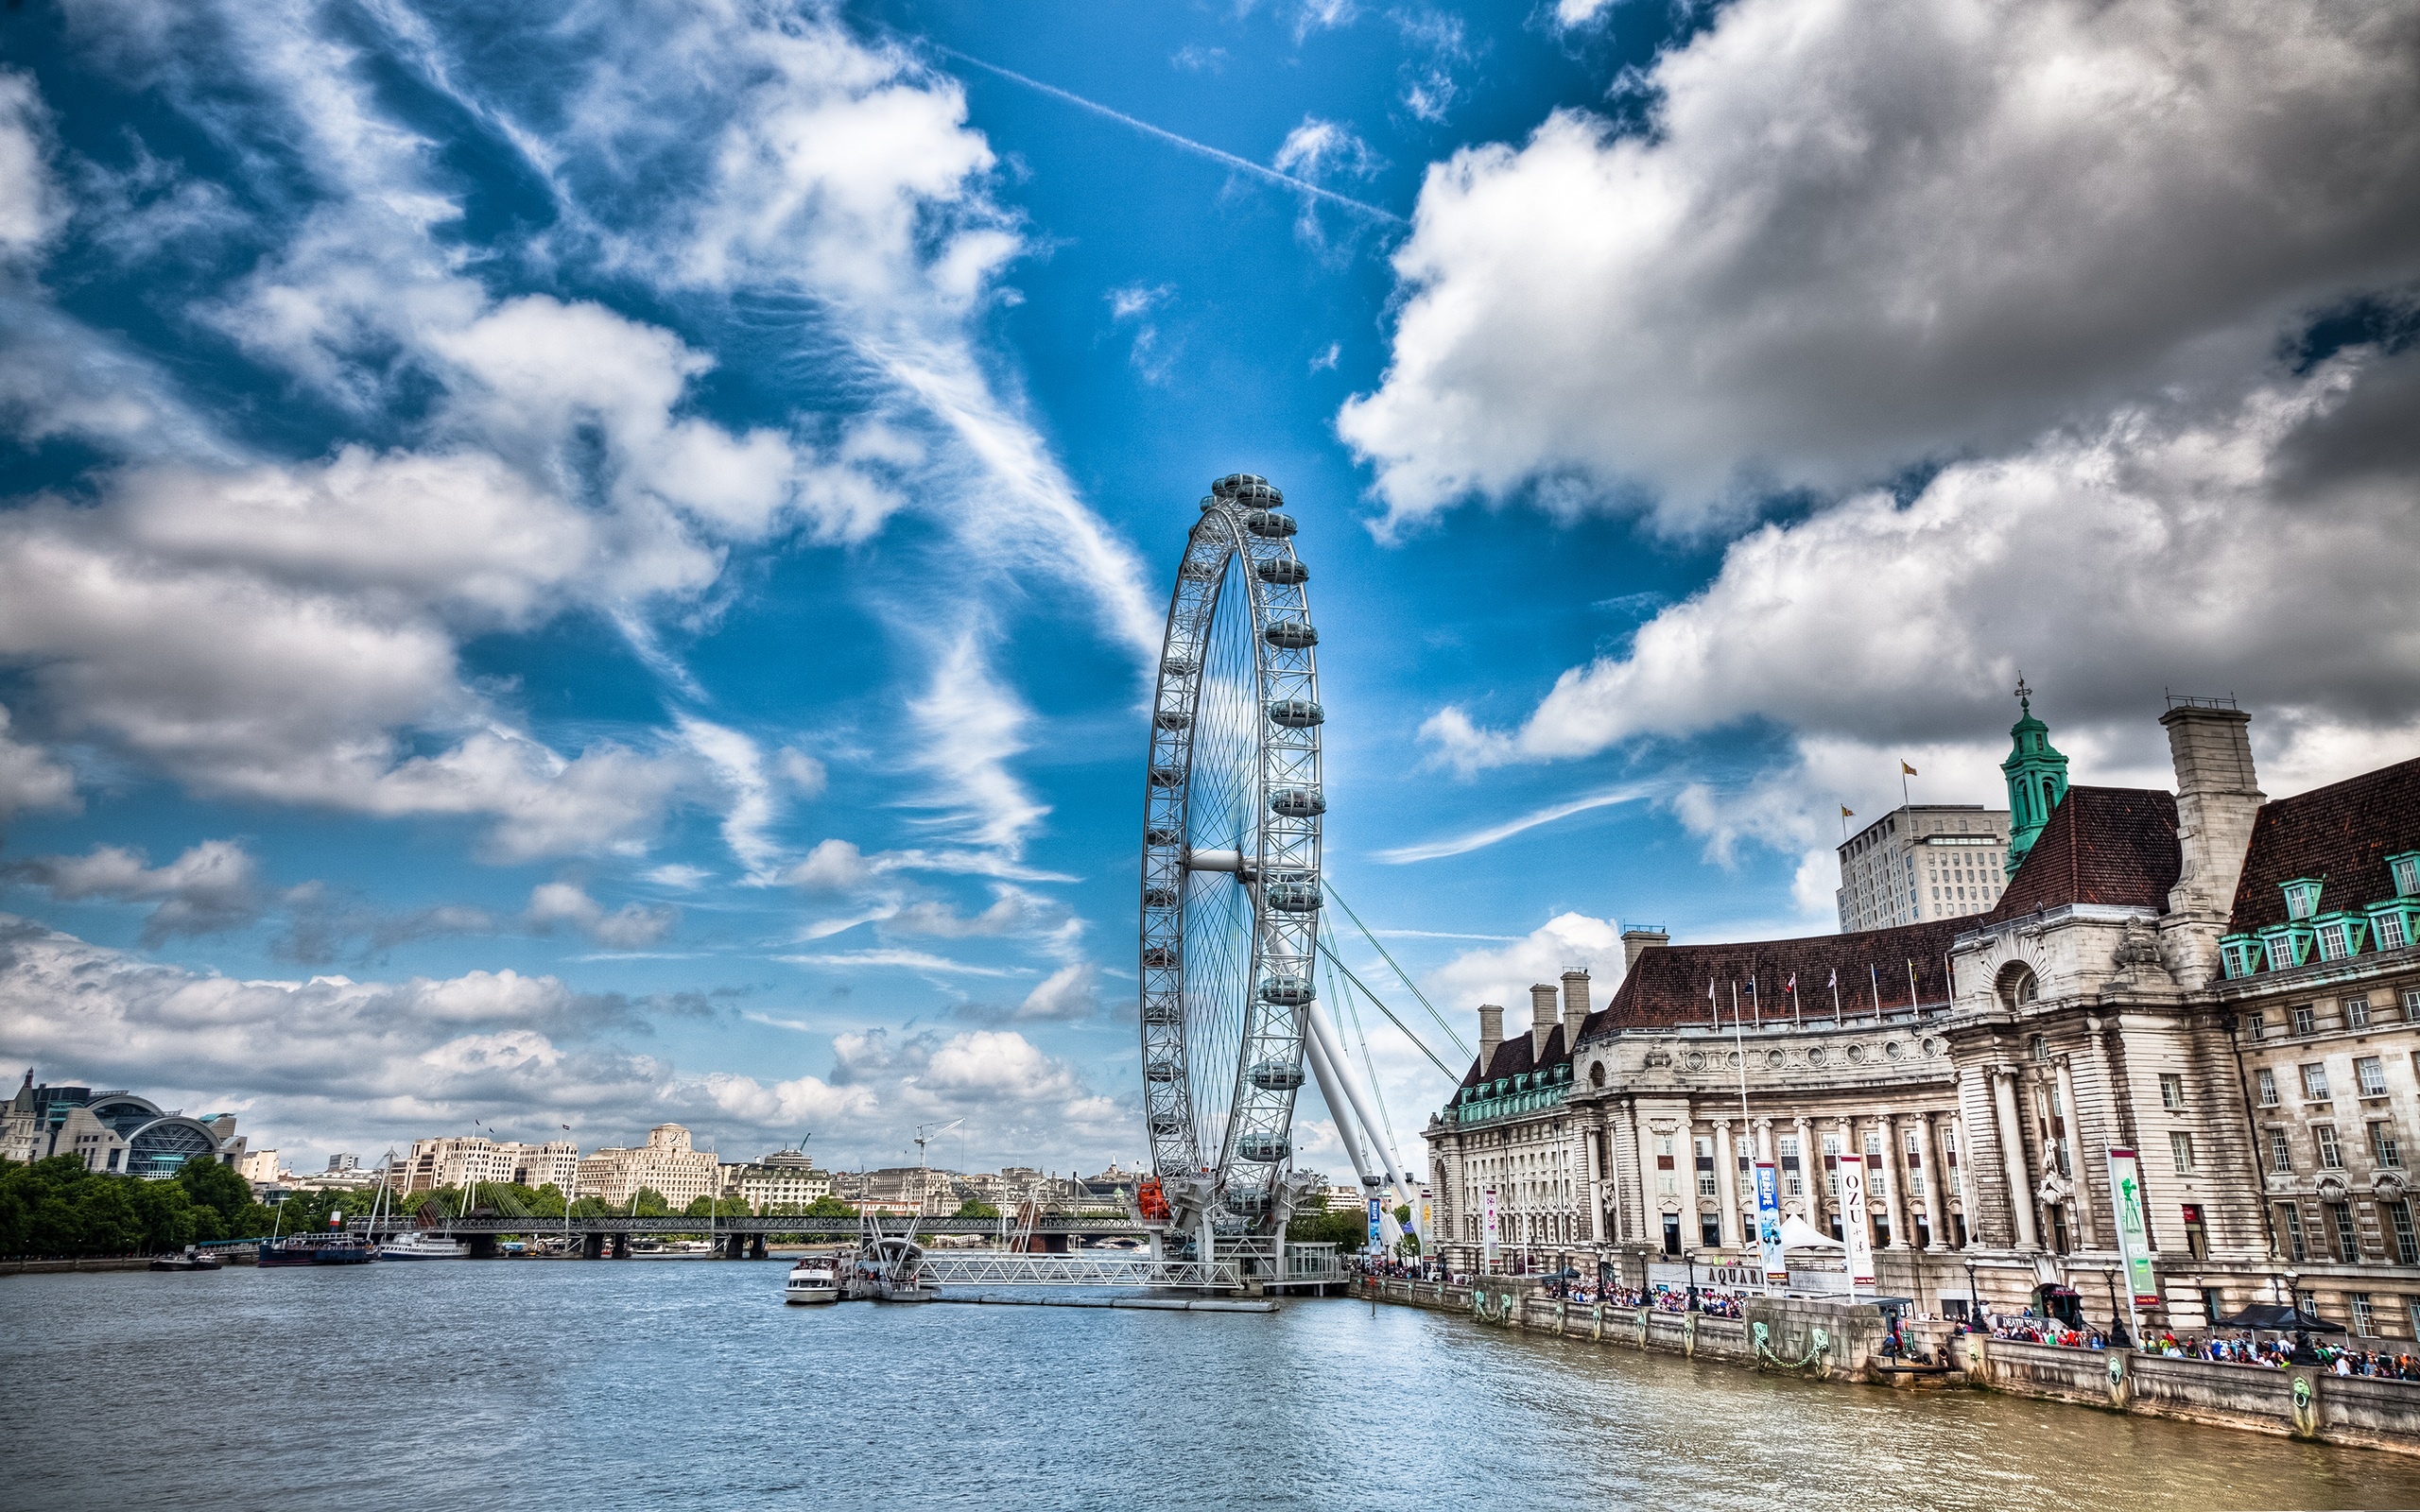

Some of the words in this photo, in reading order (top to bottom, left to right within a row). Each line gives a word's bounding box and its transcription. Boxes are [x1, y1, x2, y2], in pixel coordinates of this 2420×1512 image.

[1846, 1175, 1861, 1224] OZU
[1708, 1267, 1790, 1286] AQUARI
[2002, 1317, 2024, 1328] DEATH
